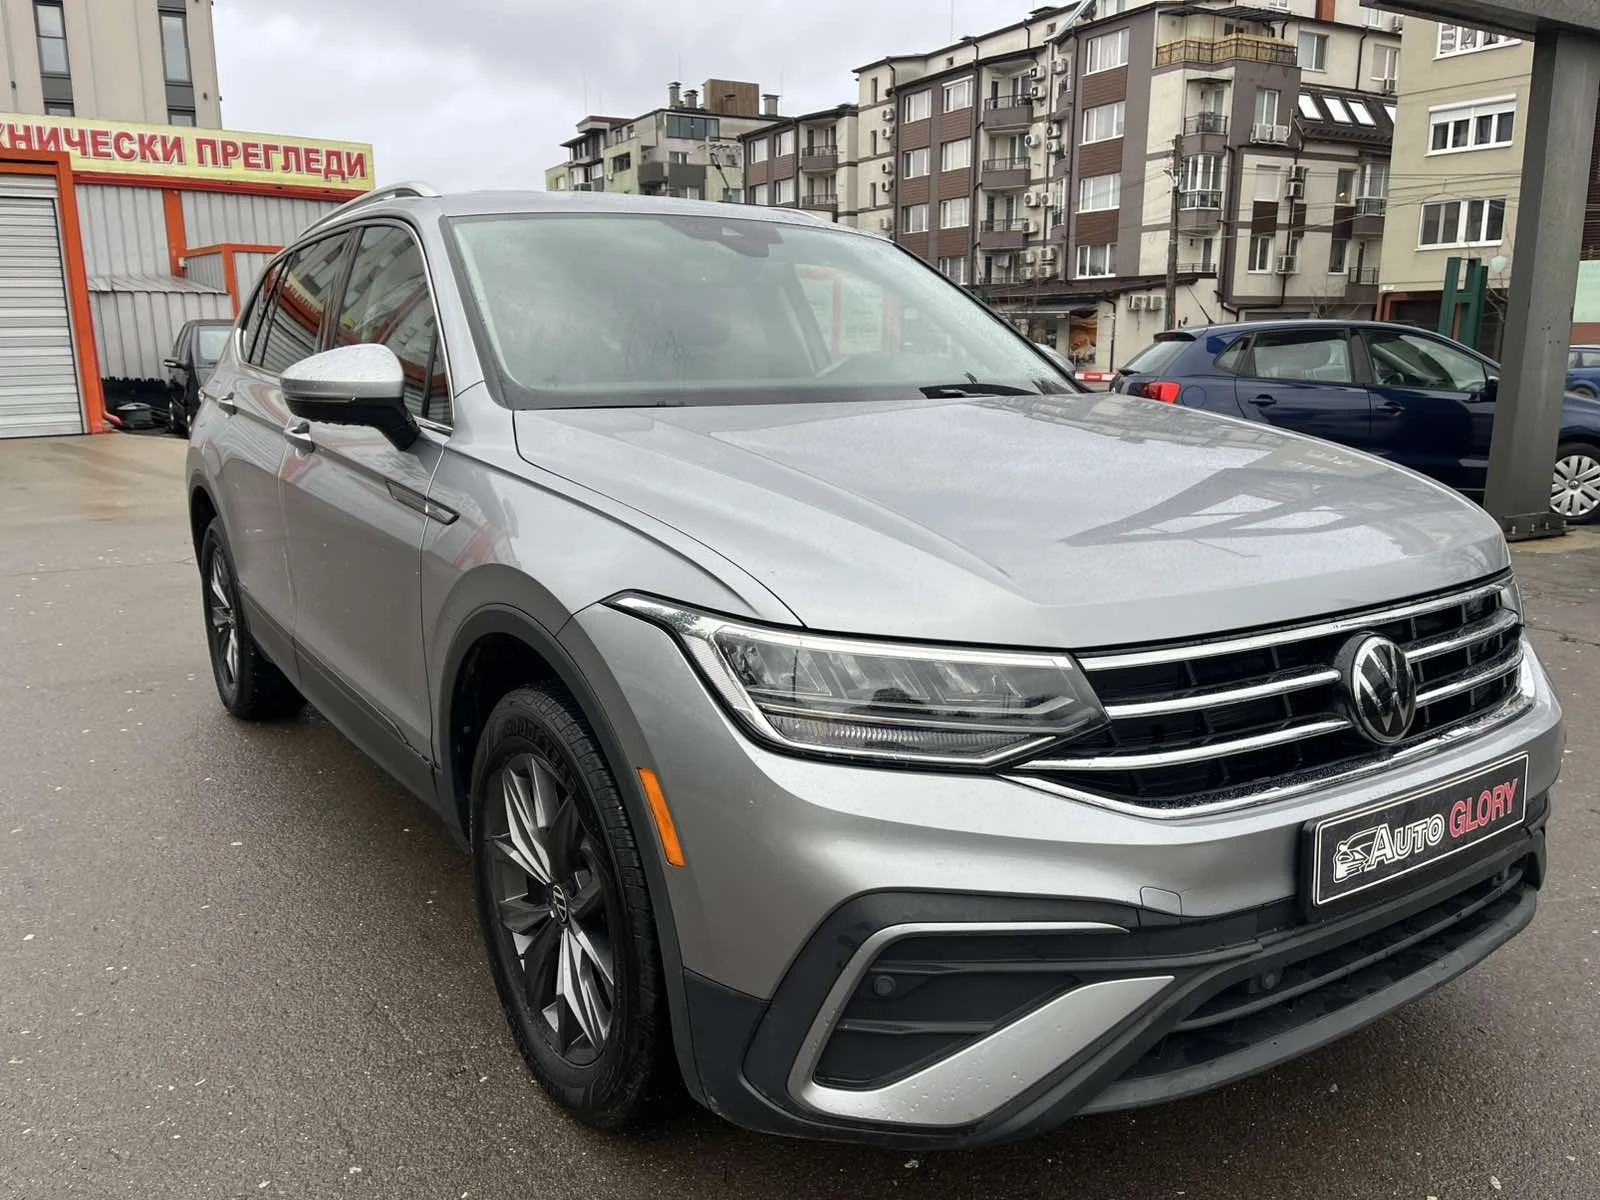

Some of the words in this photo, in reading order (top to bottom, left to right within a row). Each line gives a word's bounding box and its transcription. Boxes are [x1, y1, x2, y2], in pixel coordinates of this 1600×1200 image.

[0, 123, 186, 165] НИЧЕСКИ
[195, 136, 368, 183] ПРЕГЛЕДИ
[1449, 778, 1519, 838] GLORY
